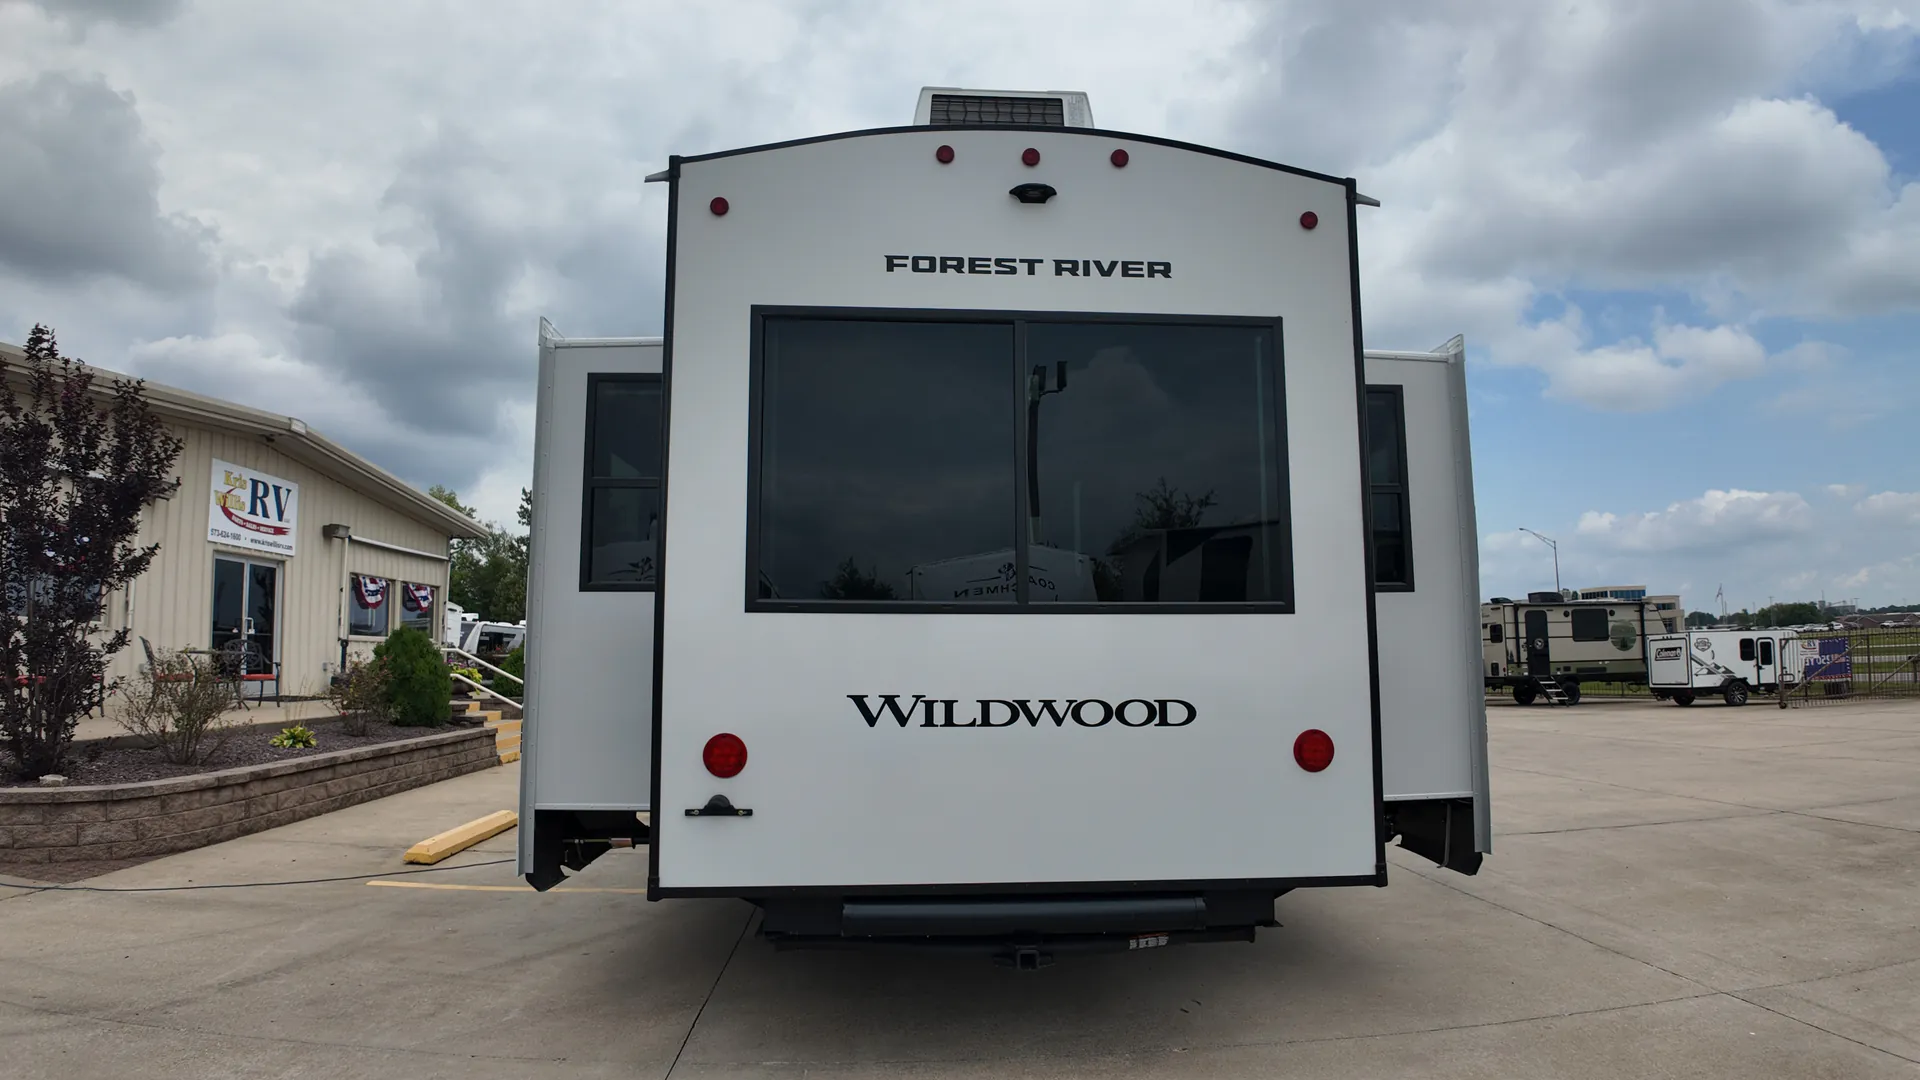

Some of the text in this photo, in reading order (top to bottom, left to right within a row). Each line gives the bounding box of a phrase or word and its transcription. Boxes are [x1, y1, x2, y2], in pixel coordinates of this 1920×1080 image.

[884, 255, 1172, 278] FOREST RIVER
[224, 470, 247, 490] Kris
[247, 478, 292, 522] RV
[1656, 649, 1677, 658] Coleman
[846, 694, 1197, 728] WILDWOOD
